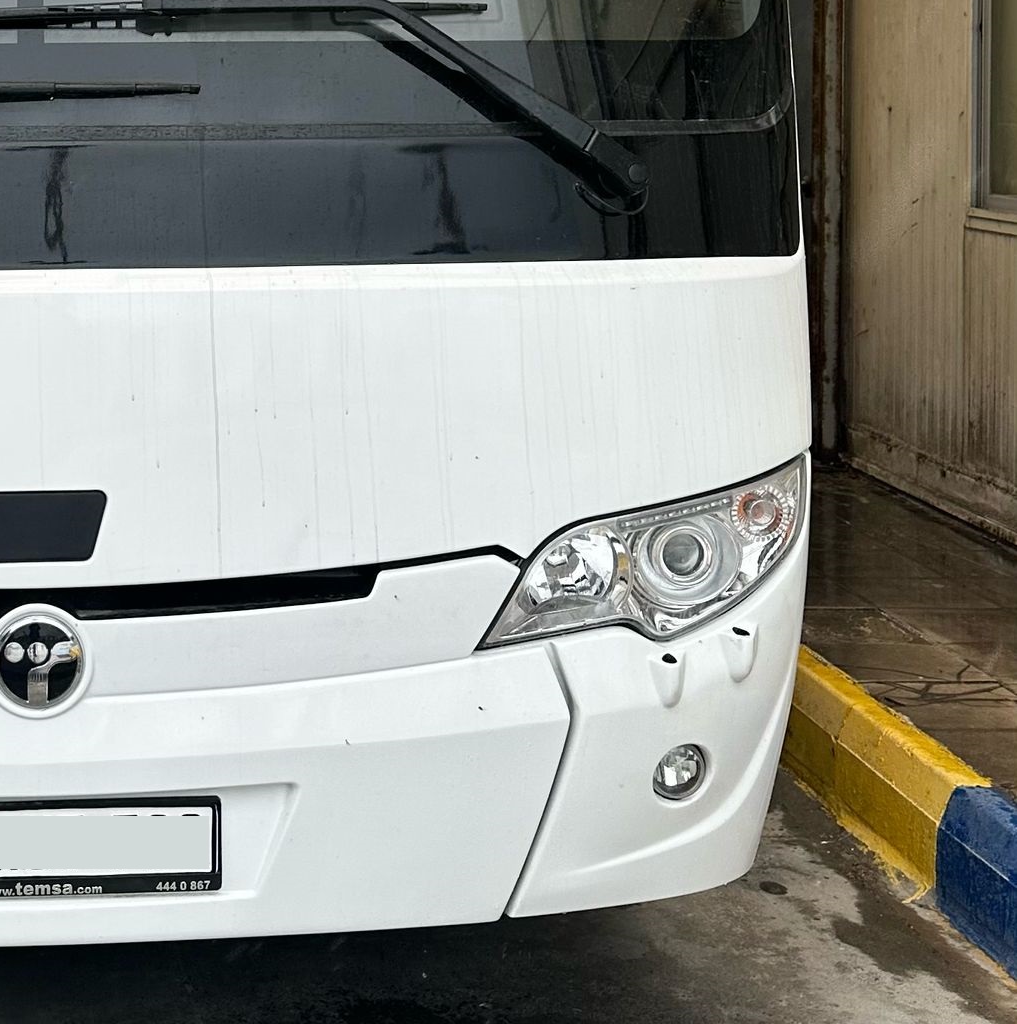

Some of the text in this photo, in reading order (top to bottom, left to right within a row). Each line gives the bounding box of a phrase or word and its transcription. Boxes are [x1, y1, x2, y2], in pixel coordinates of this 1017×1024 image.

[155, 880, 211, 892] 444 0 867
